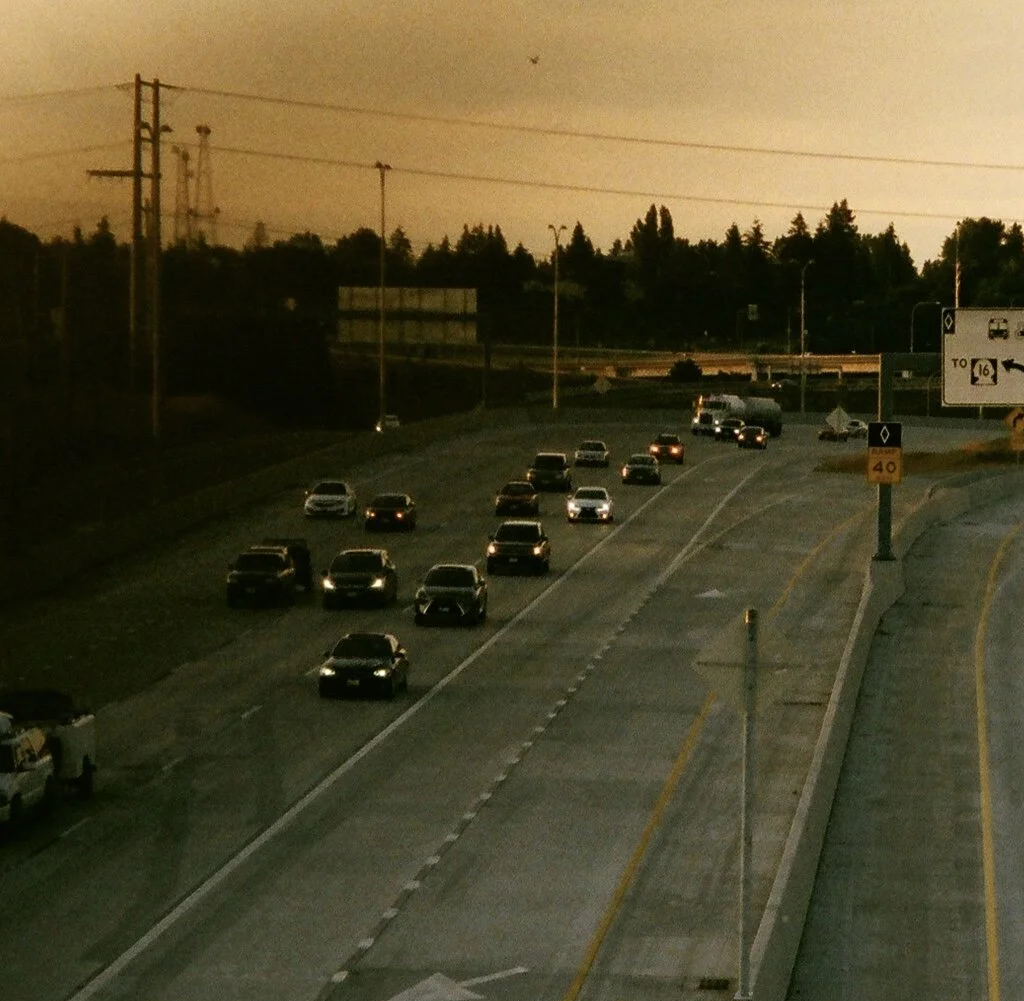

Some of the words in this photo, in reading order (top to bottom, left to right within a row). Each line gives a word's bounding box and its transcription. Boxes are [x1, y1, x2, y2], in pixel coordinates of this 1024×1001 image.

[951, 358, 968, 368] TO
[978, 364, 990, 377] 16
[873, 461, 896, 474] 40
